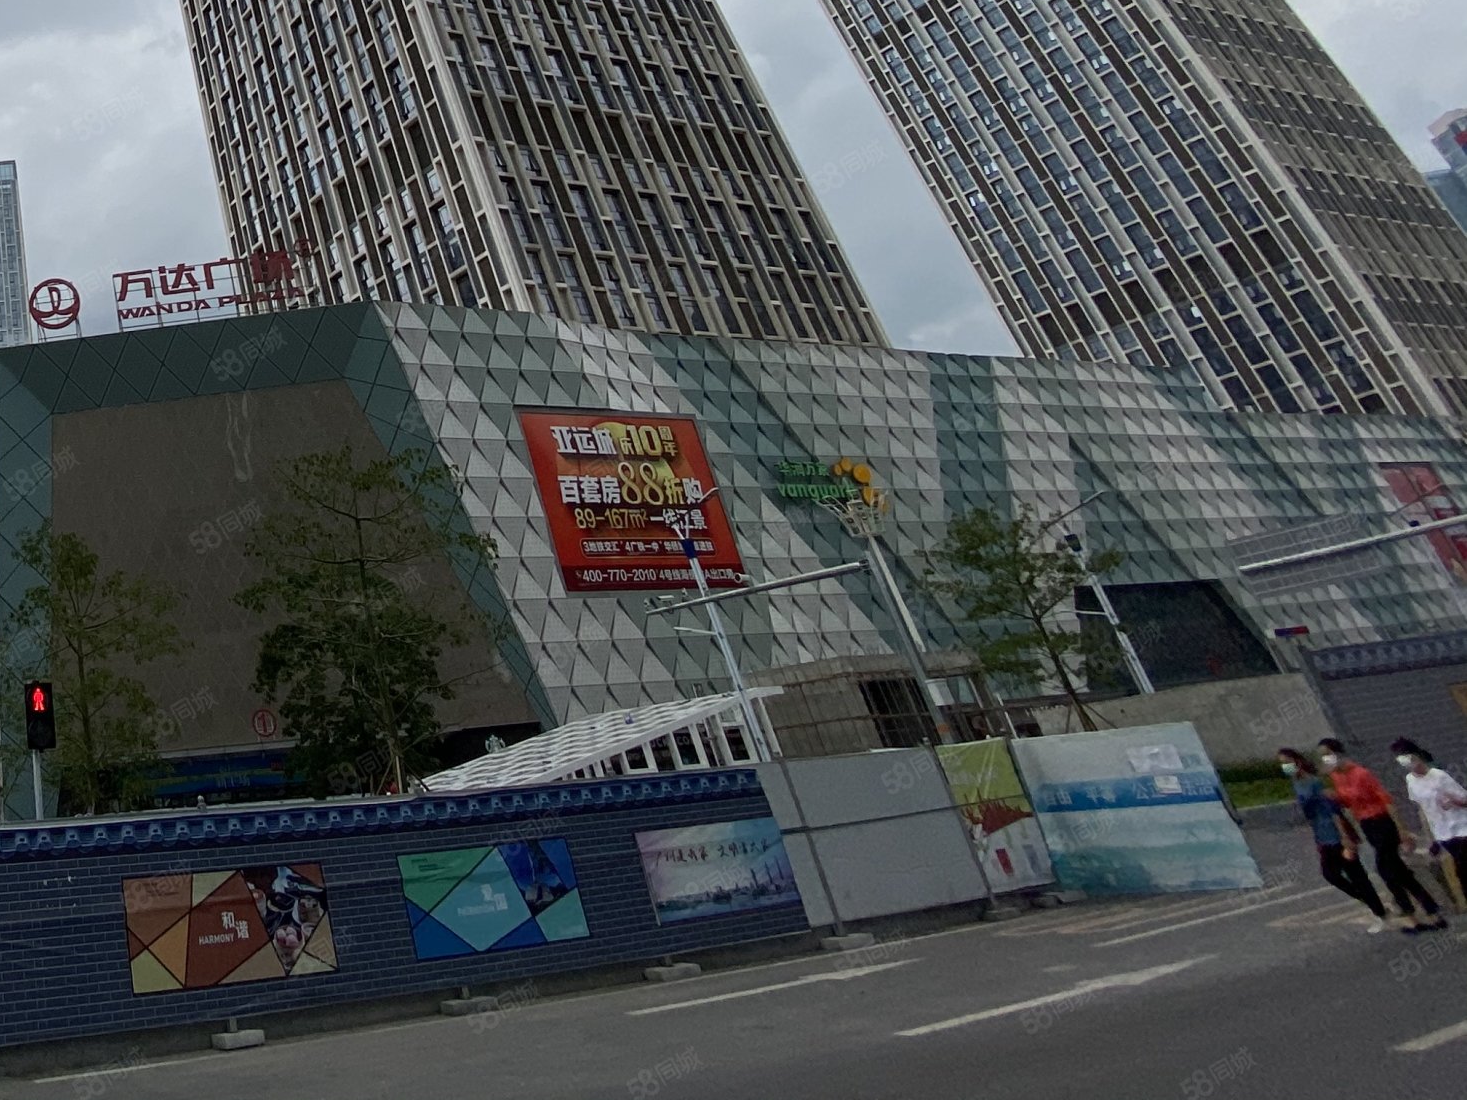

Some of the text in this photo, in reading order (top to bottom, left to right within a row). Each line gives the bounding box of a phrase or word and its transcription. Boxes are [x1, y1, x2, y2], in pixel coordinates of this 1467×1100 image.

[112, 250, 295, 301] 万达广场
[118, 299, 212, 319] WANDA
[582, 568, 656, 582] 400-770-2010
[221, 911, 250, 939] 和谐
[198, 933, 235, 946] HARMONY
